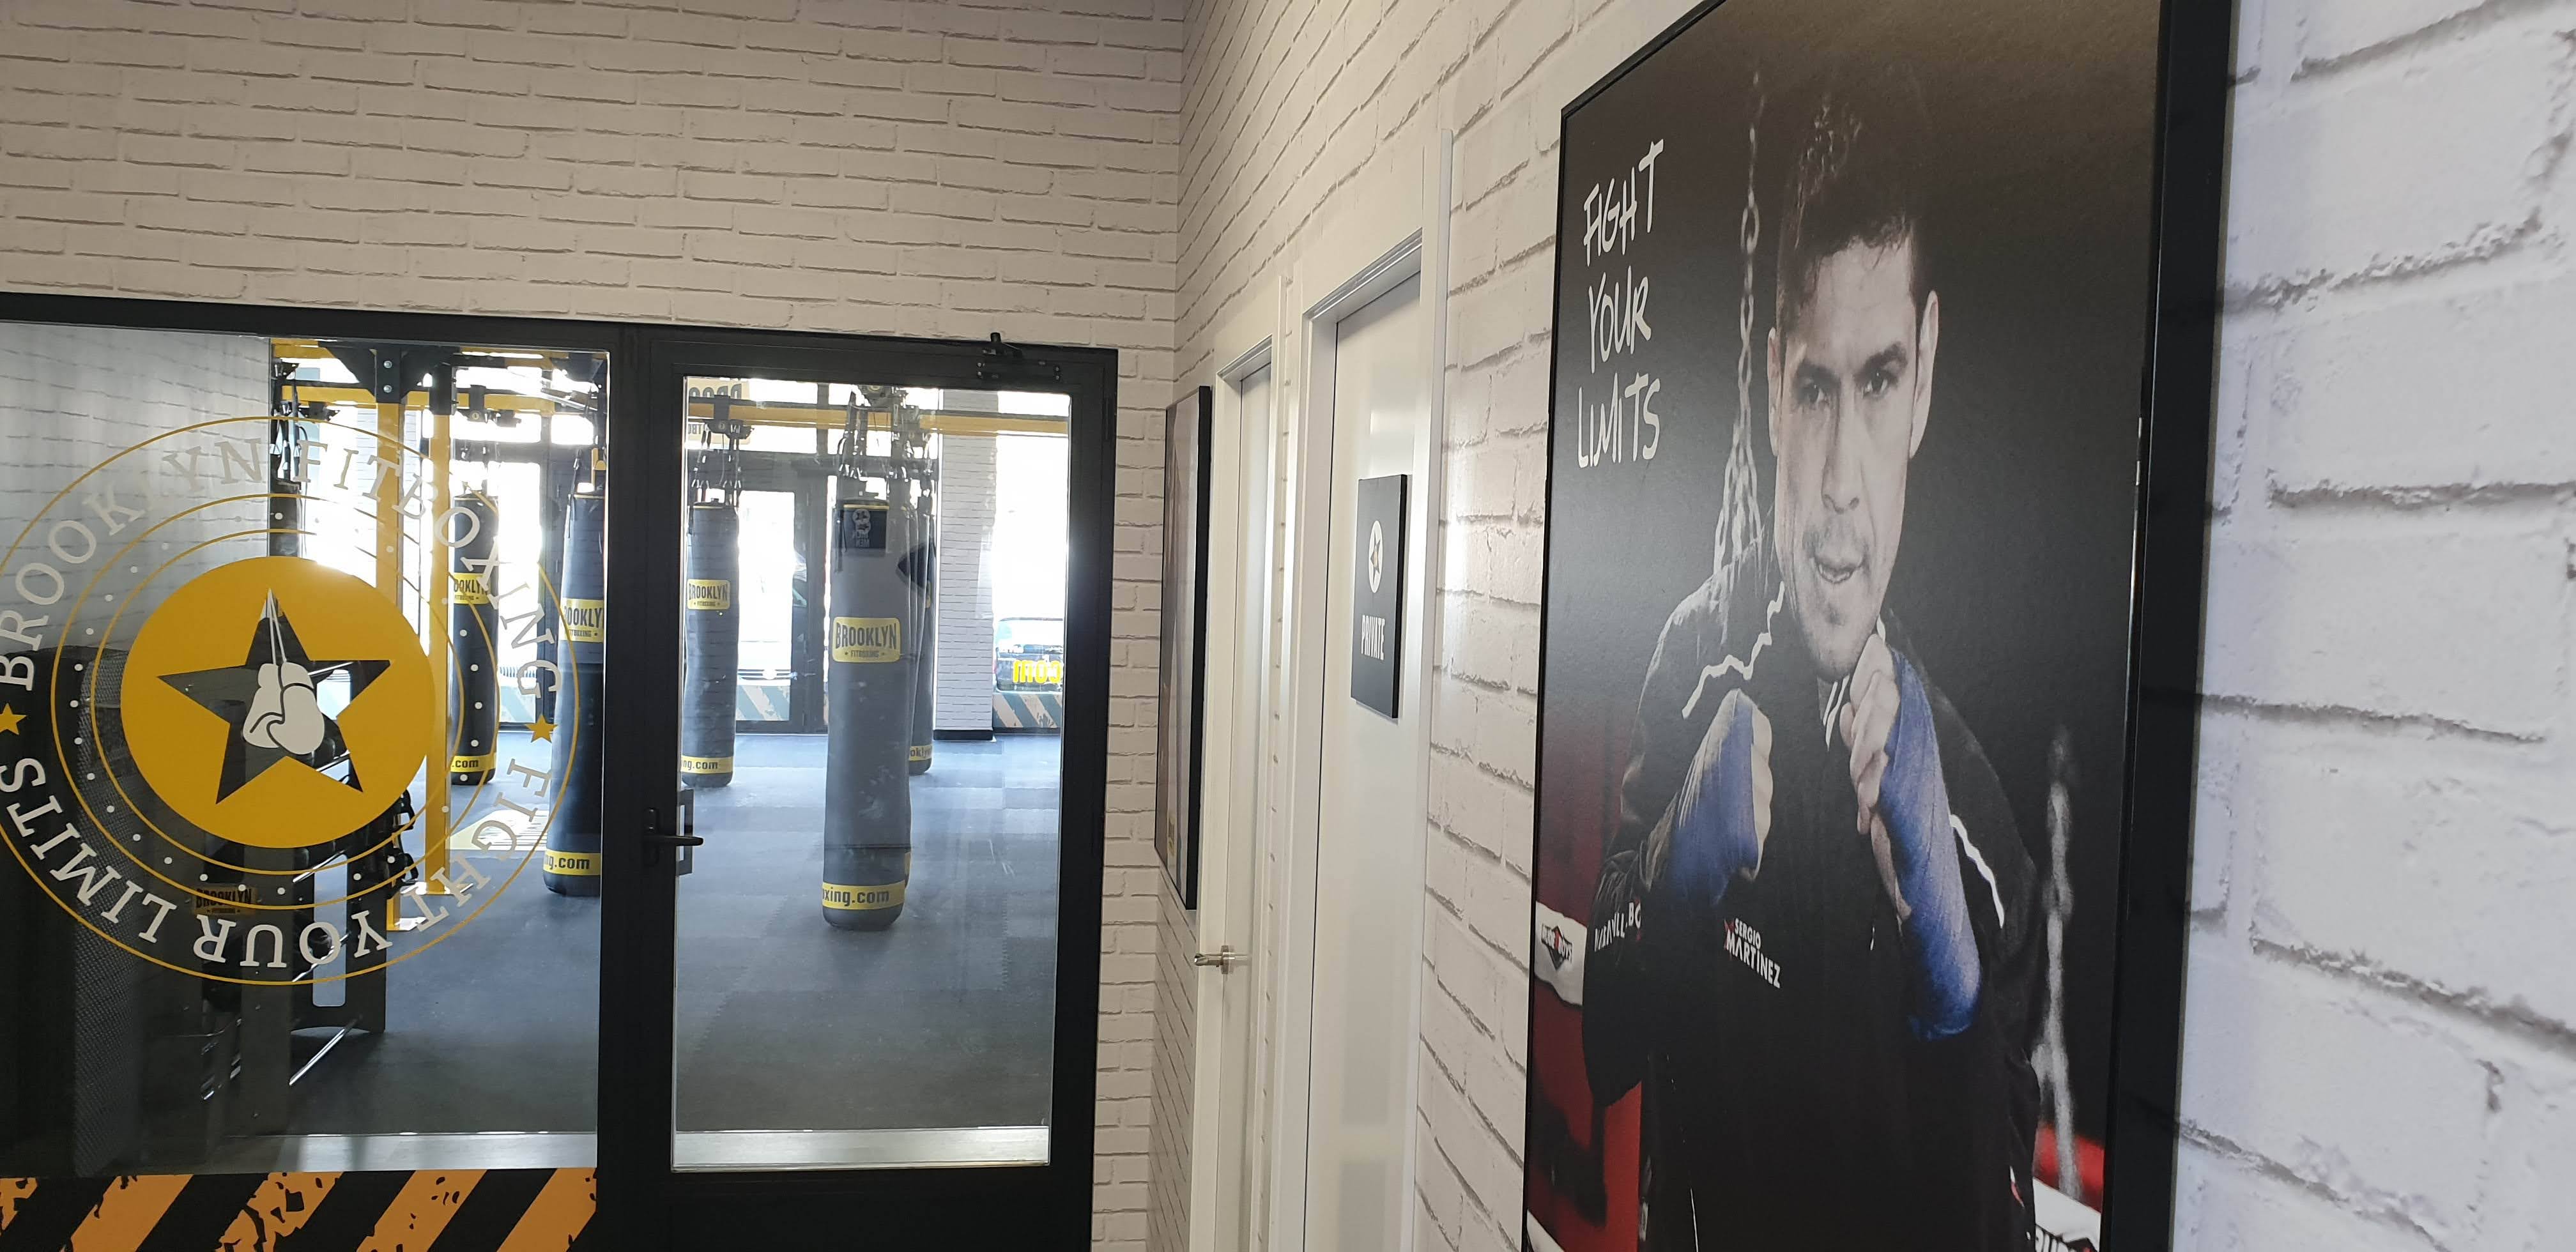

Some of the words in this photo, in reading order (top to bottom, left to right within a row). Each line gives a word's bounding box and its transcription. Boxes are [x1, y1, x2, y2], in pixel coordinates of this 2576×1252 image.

[1584, 139, 1664, 267] FIGHT
[1588, 266, 1652, 374] YOUR
[1578, 372, 1660, 468] LIMITS
[293, 439, 562, 699] FITBOXING
[689, 583, 728, 601] BROOKLYN
[835, 622, 897, 650] BROOKLYN
[1361, 615, 1386, 660] PRIVATE
[0, 758, 177, 943] LIMITS
[405, 758, 553, 932] FIGHT
[193, 910, 392, 968] YOUR
[1726, 929, 1781, 989] MARTINEZ
[1735, 918, 1761, 950] SERGIO
